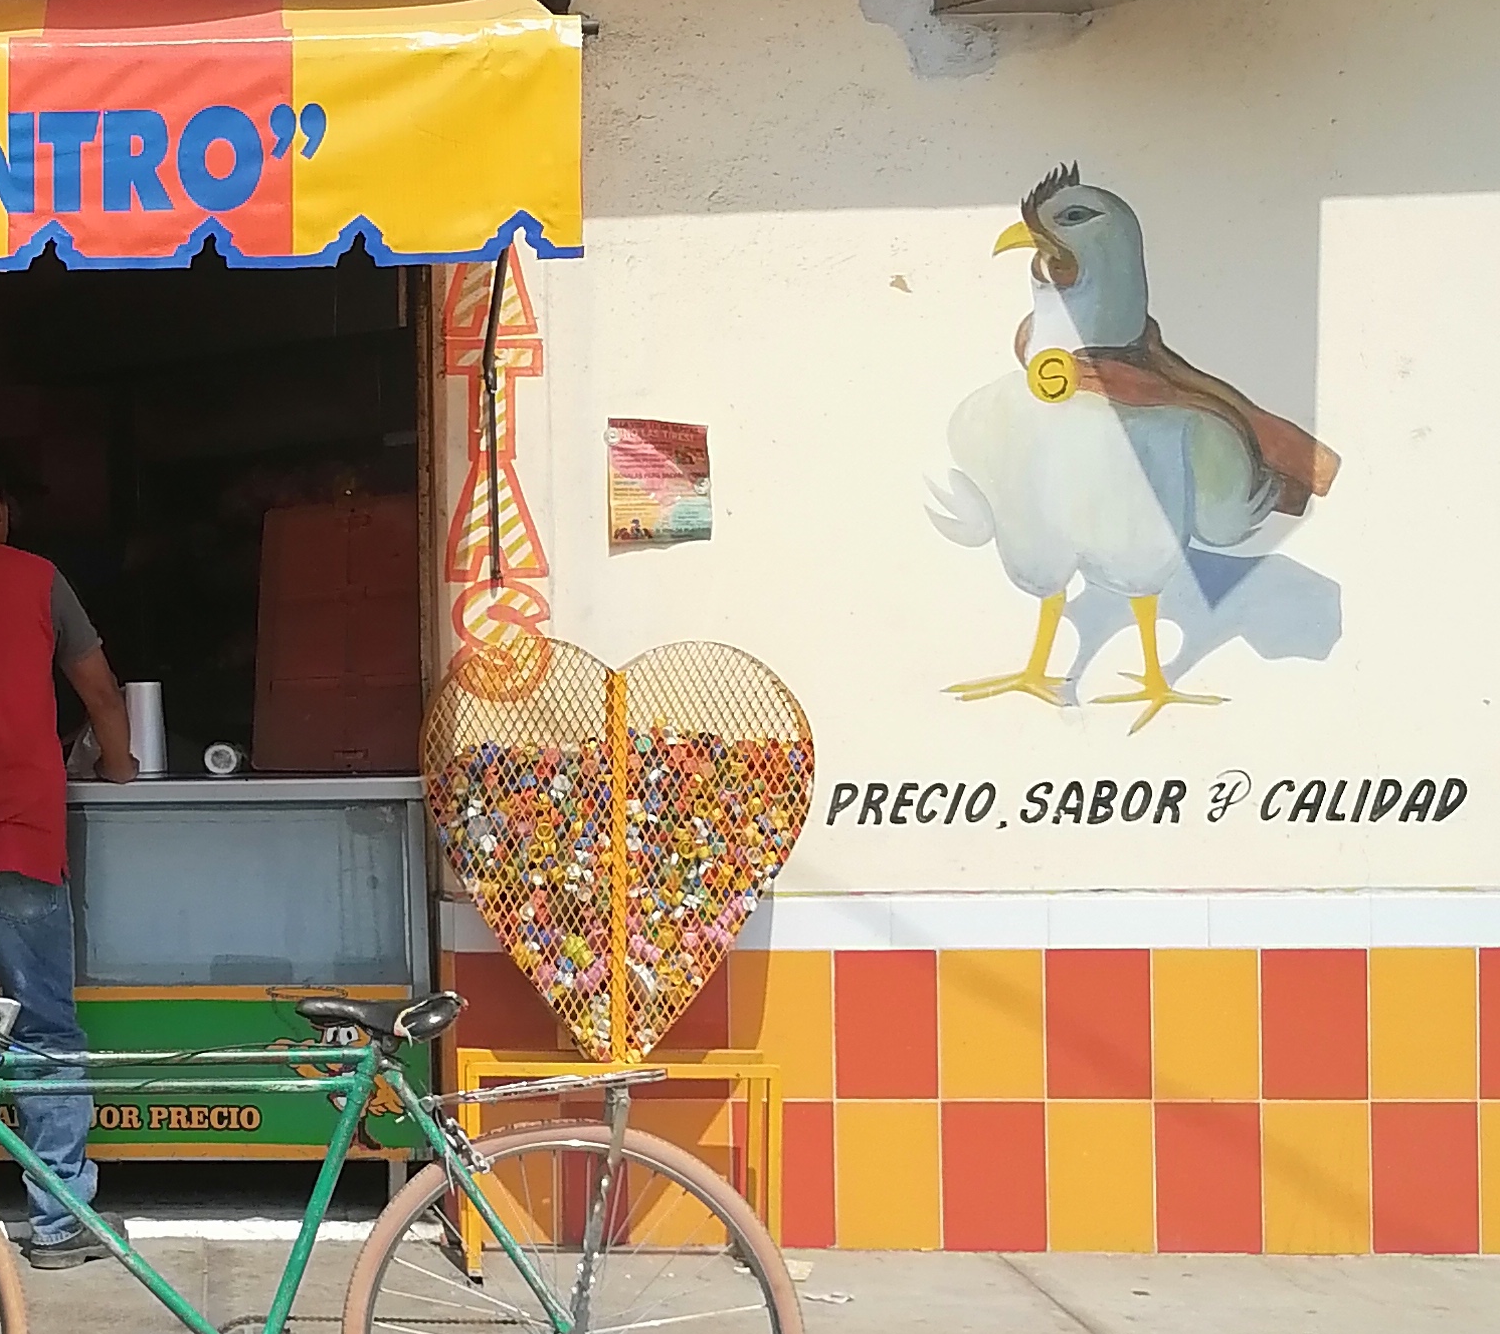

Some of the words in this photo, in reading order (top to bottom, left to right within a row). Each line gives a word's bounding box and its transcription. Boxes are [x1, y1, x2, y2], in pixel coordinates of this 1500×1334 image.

[1038, 357, 1068, 400] S
[826, 780, 1008, 830] PRECIO,
[1020, 779, 1187, 826] SABOR
[1260, 777, 1468, 824] CALIDAD
[149, 1106, 262, 1129] PRECIO
